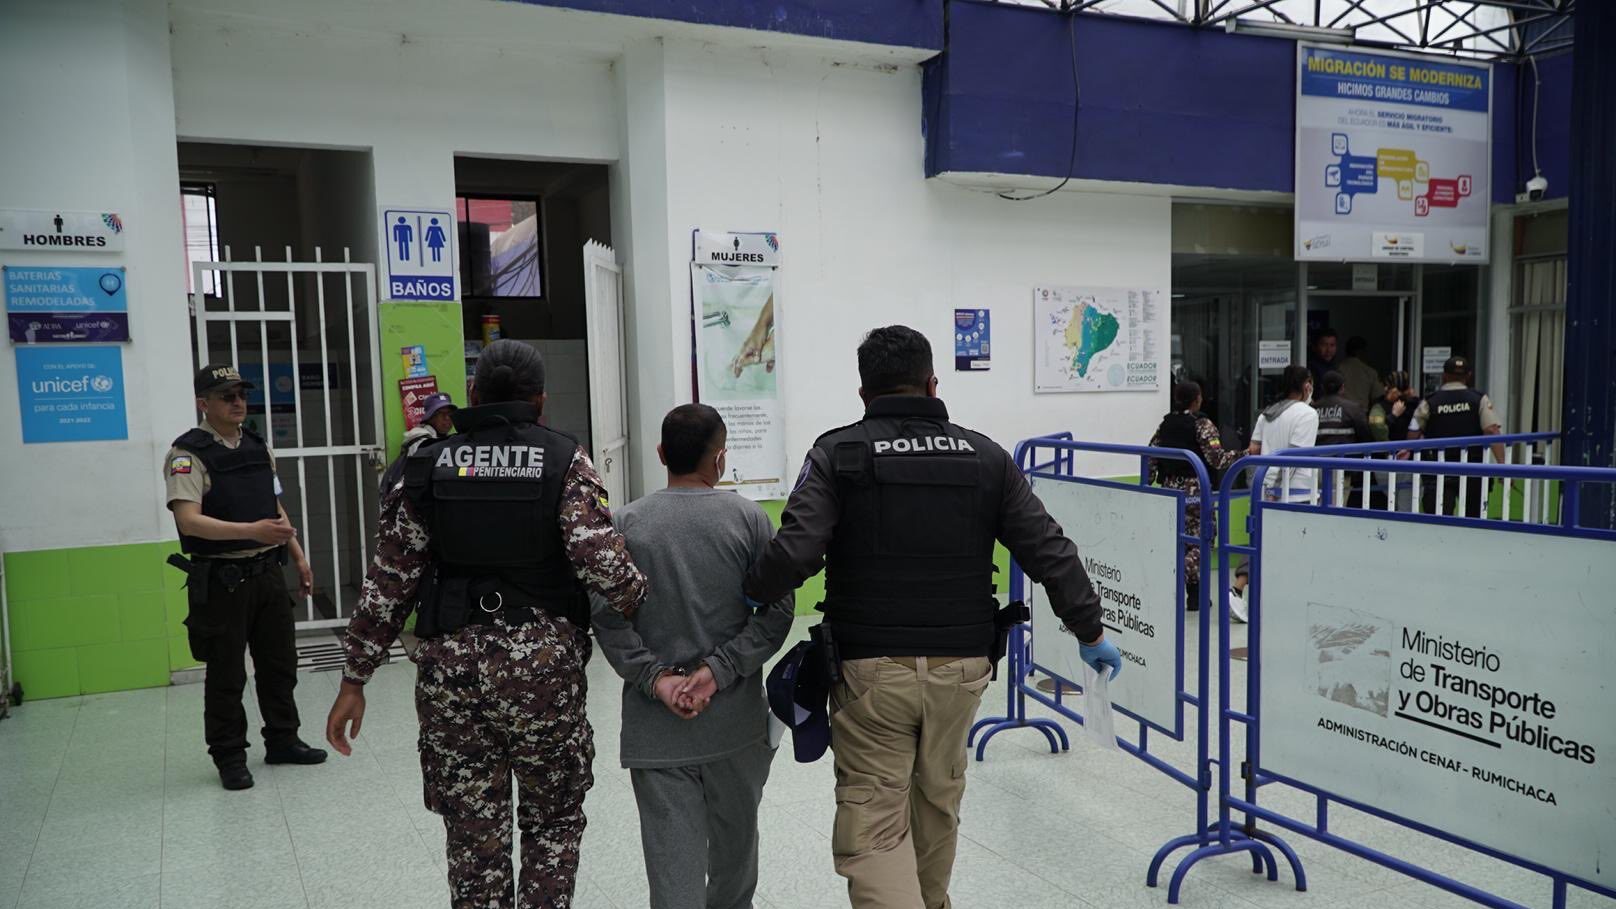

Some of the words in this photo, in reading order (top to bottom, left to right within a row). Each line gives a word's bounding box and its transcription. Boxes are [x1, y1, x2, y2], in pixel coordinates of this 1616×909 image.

[1308, 56, 1385, 78] MIGRACIÓN
[1389, 66, 1406, 81] SE
[1410, 68, 1482, 89] MODERNIZA
[1338, 82, 1373, 97] HICIMOS
[1375, 85, 1412, 101] GRANDES
[1414, 90, 1450, 105] CAMBIOS
[23, 234, 107, 247] HOMBRES
[711, 252, 764, 263] MUJERES
[9, 271, 62, 281] BATERIAS
[10, 284, 75, 293] SANITARIAS
[392, 280, 451, 297] BAÑOS
[11, 297, 96, 306] REMODELADAS
[1260, 356, 1289, 365] ENTRADA
[32, 376, 89, 393] unicef
[1126, 375, 1157, 383] ECUADOR
[34, 404, 55, 413] para
[56, 403, 79, 411] cada
[80, 402, 115, 410] infancia
[1316, 404, 1343, 418] OLICÍA
[1437, 402, 1470, 414] POLICIA
[873, 436, 975, 453] POLICIA
[435, 446, 545, 467] AGENTE
[473, 466, 543, 478] PENITENCIARIO
[1084, 557, 1121, 582] Ministerio
[1096, 580, 1141, 610] Transporte
[1117, 608, 1155, 638] Públicas
[1402, 626, 1500, 672] Ministerio
[1400, 657, 1425, 682] de
[1430, 664, 1556, 719] Transporte
[1398, 689, 1411, 711] y
[1416, 690, 1483, 729] Obras
[1489, 711, 1596, 764] Públicas
[1317, 716, 1417, 759] ADMINISTRACIÓN
[1472, 767, 1557, 806] RUMICHACA
